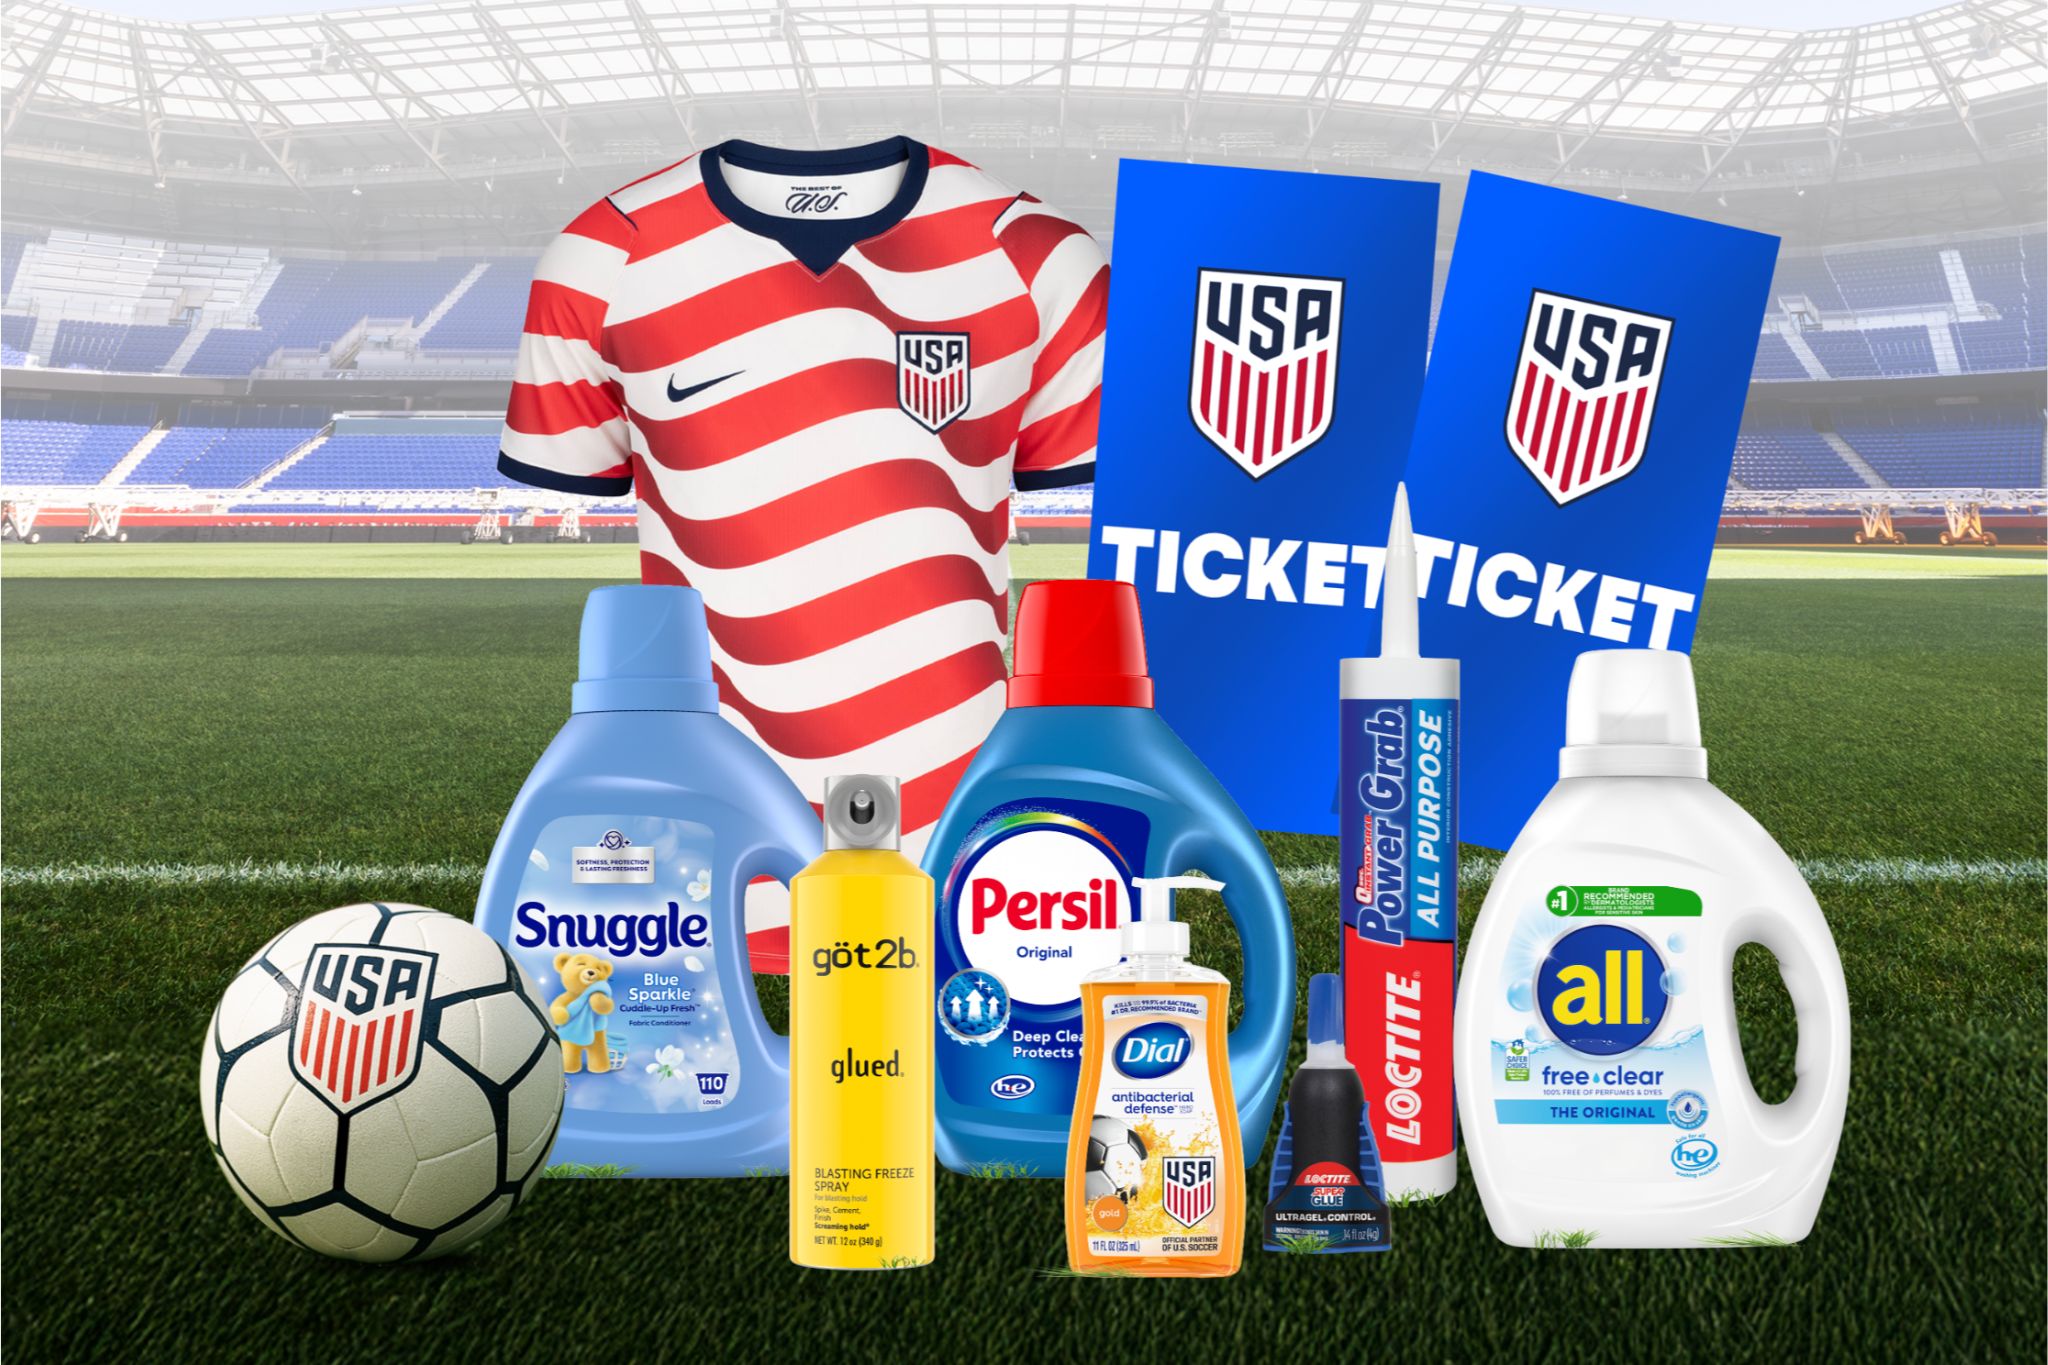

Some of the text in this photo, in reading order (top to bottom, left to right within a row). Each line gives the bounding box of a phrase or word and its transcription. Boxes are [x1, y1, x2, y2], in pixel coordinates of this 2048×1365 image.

[1207, 281, 1333, 361] USA
[1533, 302, 1658, 390] USA
[905, 339, 963, 375] USA
[1101, 525, 1387, 609] TICKET
[1413, 532, 1696, 650] TICKET
[1417, 710, 1442, 928] ALL PURPOSE
[1357, 709, 1404, 947] Power Grab
[1551, 890, 1568, 911] #1
[1583, 892, 1655, 900] RECOMMENDED
[972, 877, 1117, 935] Persil
[515, 901, 708, 957] Snuggle
[813, 936, 916, 976] göt2b
[1016, 945, 1072, 962] Original
[313, 954, 423, 1016] USA
[644, 973, 679, 986] Blue
[1552, 950, 1643, 1025] all
[629, 987, 691, 1004] Sparkle
[619, 1004, 695, 1013] Cuddle-Up Fresh
[1167, 1000, 1197, 1008] BACTERIA
[1177, 1007, 1199, 1015] BRAND
[1013, 1030, 1051, 1045] Deep
[1013, 1047, 1074, 1059] Protects
[1122, 1037, 1184, 1063] Dial
[831, 1047, 900, 1083] glued
[1385, 971, 1422, 1145] LOCTITE
[1542, 1065, 1590, 1086] free
[1603, 1065, 1664, 1086] clear
[699, 1076, 723, 1090] 110
[997, 1079, 1027, 1094] he
[1112, 1091, 1194, 1103] antibacterial
[1124, 1102, 1174, 1114] defense
[1550, 1106, 1655, 1118] THE ORIGINAL
[1677, 1144, 1709, 1165] he
[815, 1168, 915, 1179] BLASTING FREEZE
[1166, 1160, 1211, 1187] USA
[1304, 1174, 1351, 1184] LOCTITE
[814, 1181, 849, 1192] SPRAY
[1312, 1187, 1345, 1196] SUPER
[825, 1194, 851, 1203] blasting
[1311, 1196, 1344, 1206] GLUE
[814, 1206, 831, 1214] Spike,
[1099, 1208, 1120, 1219] gold
[1275, 1213, 1373, 1222] ULTRAGEL CONTROL
[814, 1222, 848, 1231] Screaming
[1351, 1229, 1357, 1240] fl
[1357, 1230, 1366, 1240] oz
[814, 1236, 825, 1245] NET
[840, 1236, 848, 1246] 12
[858, 1236, 874, 1247] (340
[875, 1236, 883, 1248] g)
[1092, 1241, 1100, 1251] 11
[1100, 1241, 1107, 1251] FL
[1188, 1243, 1218, 1251] SOCCER
